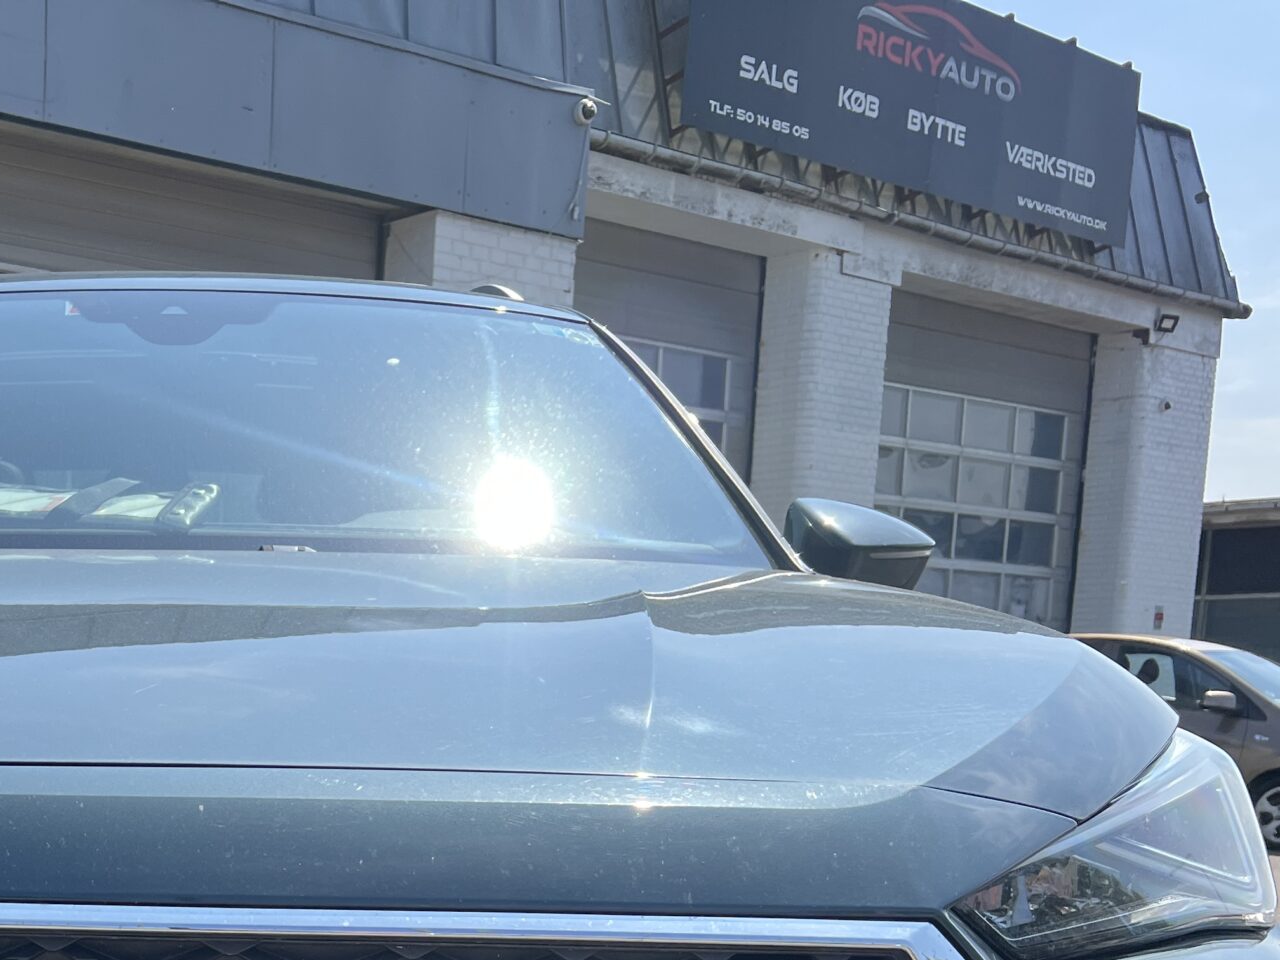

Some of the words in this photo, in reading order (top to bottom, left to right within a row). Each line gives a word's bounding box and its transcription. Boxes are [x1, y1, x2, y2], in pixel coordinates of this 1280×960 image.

[709, 100, 734, 118] TLF:
[736, 108, 755, 123] 50
[756, 114, 770, 128] 14
[771, 119, 790, 134] 85
[792, 125, 810, 139] 05
[739, 54, 799, 94] SALG
[838, 85, 880, 119] KØB
[907, 108, 967, 147] BYTTE
[1006, 141, 1096, 188] VÆRKSTED
